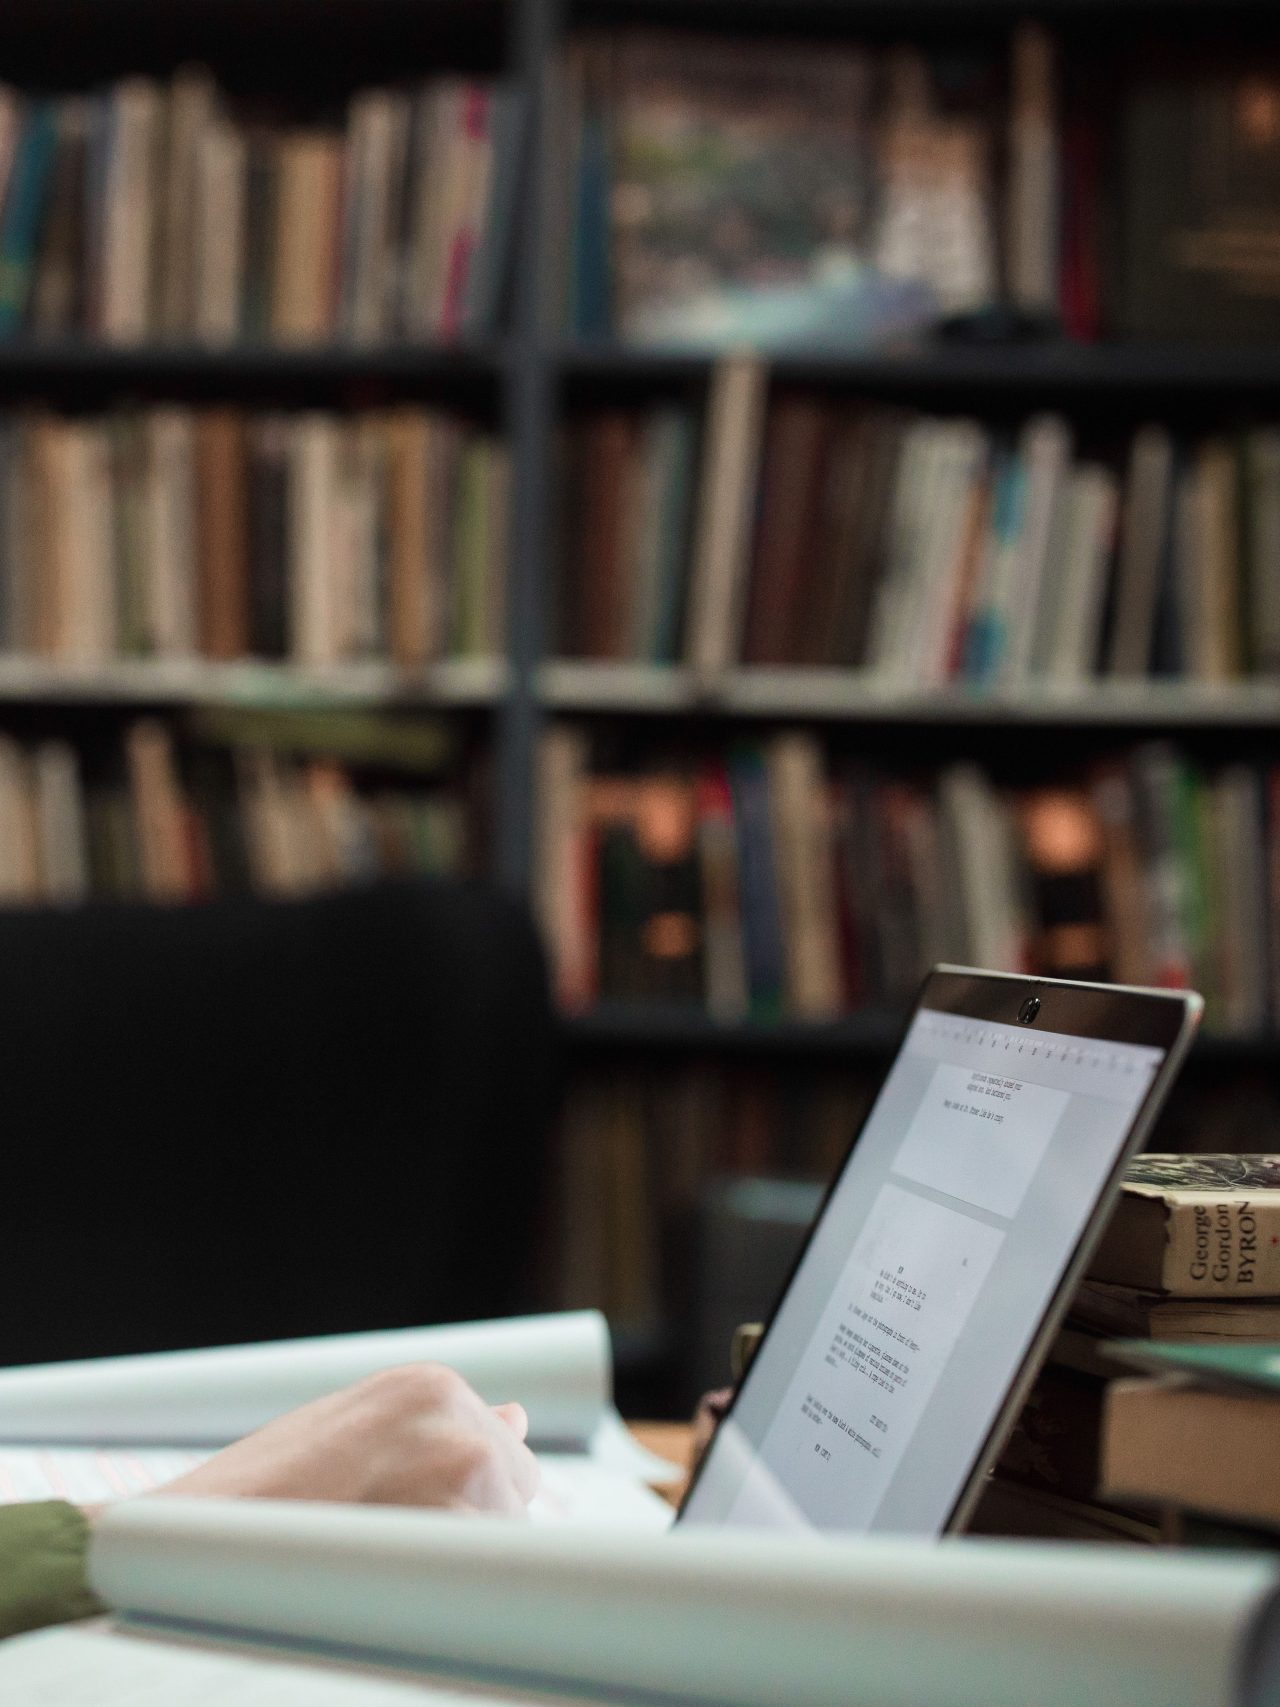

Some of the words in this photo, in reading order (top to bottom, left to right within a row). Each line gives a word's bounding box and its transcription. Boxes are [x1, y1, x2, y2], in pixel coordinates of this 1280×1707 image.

[1190, 1205, 1211, 1280] George
[1212, 1203, 1232, 1282] Gordon
[1236, 1200, 1257, 1283] BYRON
